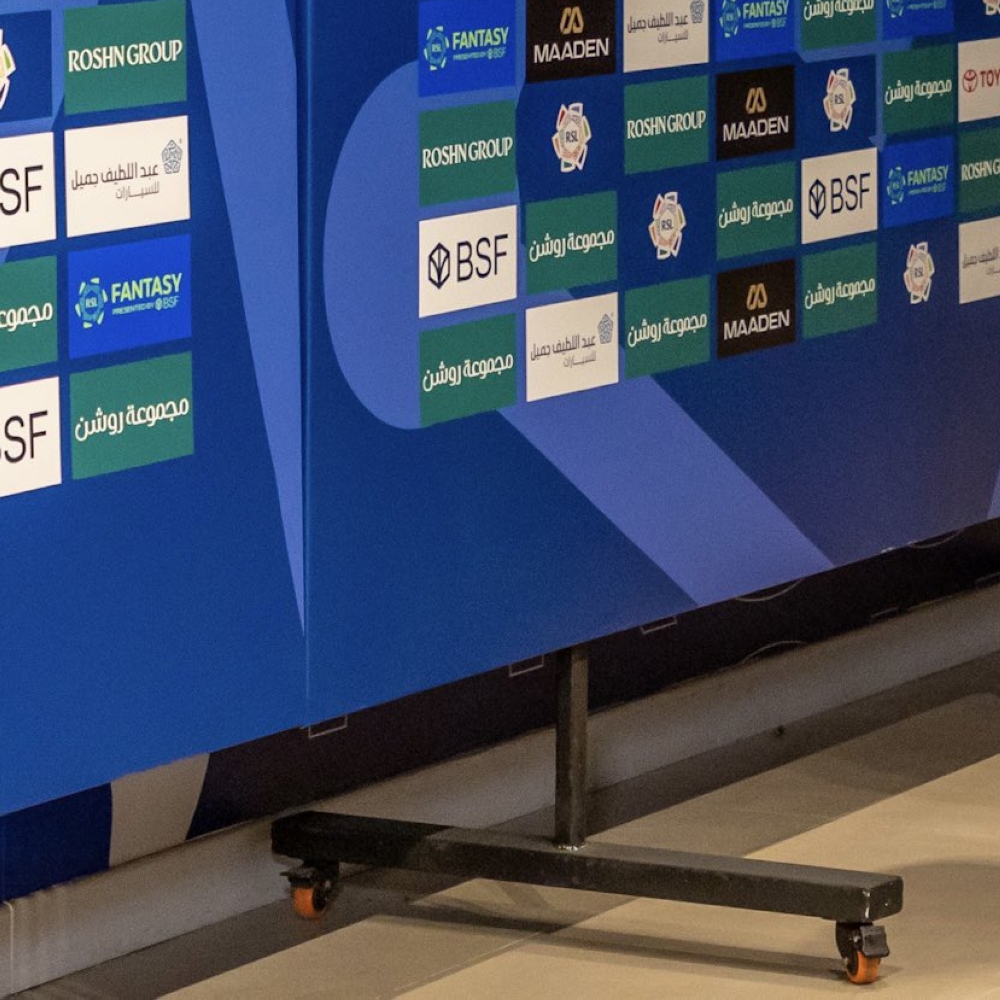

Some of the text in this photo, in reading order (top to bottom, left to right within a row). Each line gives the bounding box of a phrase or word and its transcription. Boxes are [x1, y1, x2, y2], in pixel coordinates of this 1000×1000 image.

[675, 15, 688, 25] عبد
[452, 27, 508, 49] FANTASY
[534, 37, 608, 63] MAADEN
[68, 39, 182, 71] ROSHN GROUP
[885, 79, 951, 104] مجموعة روشن
[566, 130, 578, 143] RSL
[627, 110, 706, 139] ROSHN GROUP
[723, 115, 788, 141] MAADEN
[422, 136, 513, 168] ROSHN GROUP
[0, 164, 44, 216] SF
[72, 162, 158, 190] عبد اللطيف جميل
[907, 165, 948, 186] FANTASY
[831, 172, 870, 214] BSF
[718, 199, 793, 228] مجموعة روشن
[457, 233, 508, 282] BSF
[111, 273, 181, 302] FANTASY
[162, 295, 178, 308] BSF
[627, 313, 707, 347] مجموعة روشن
[724, 309, 789, 339] MAADEN
[582, 335, 595, 347] عبد
[422, 354, 513, 391] مجموعة روشن
[75, 399, 189, 441] مجموعة روشن
[0, 409, 48, 464] SF
